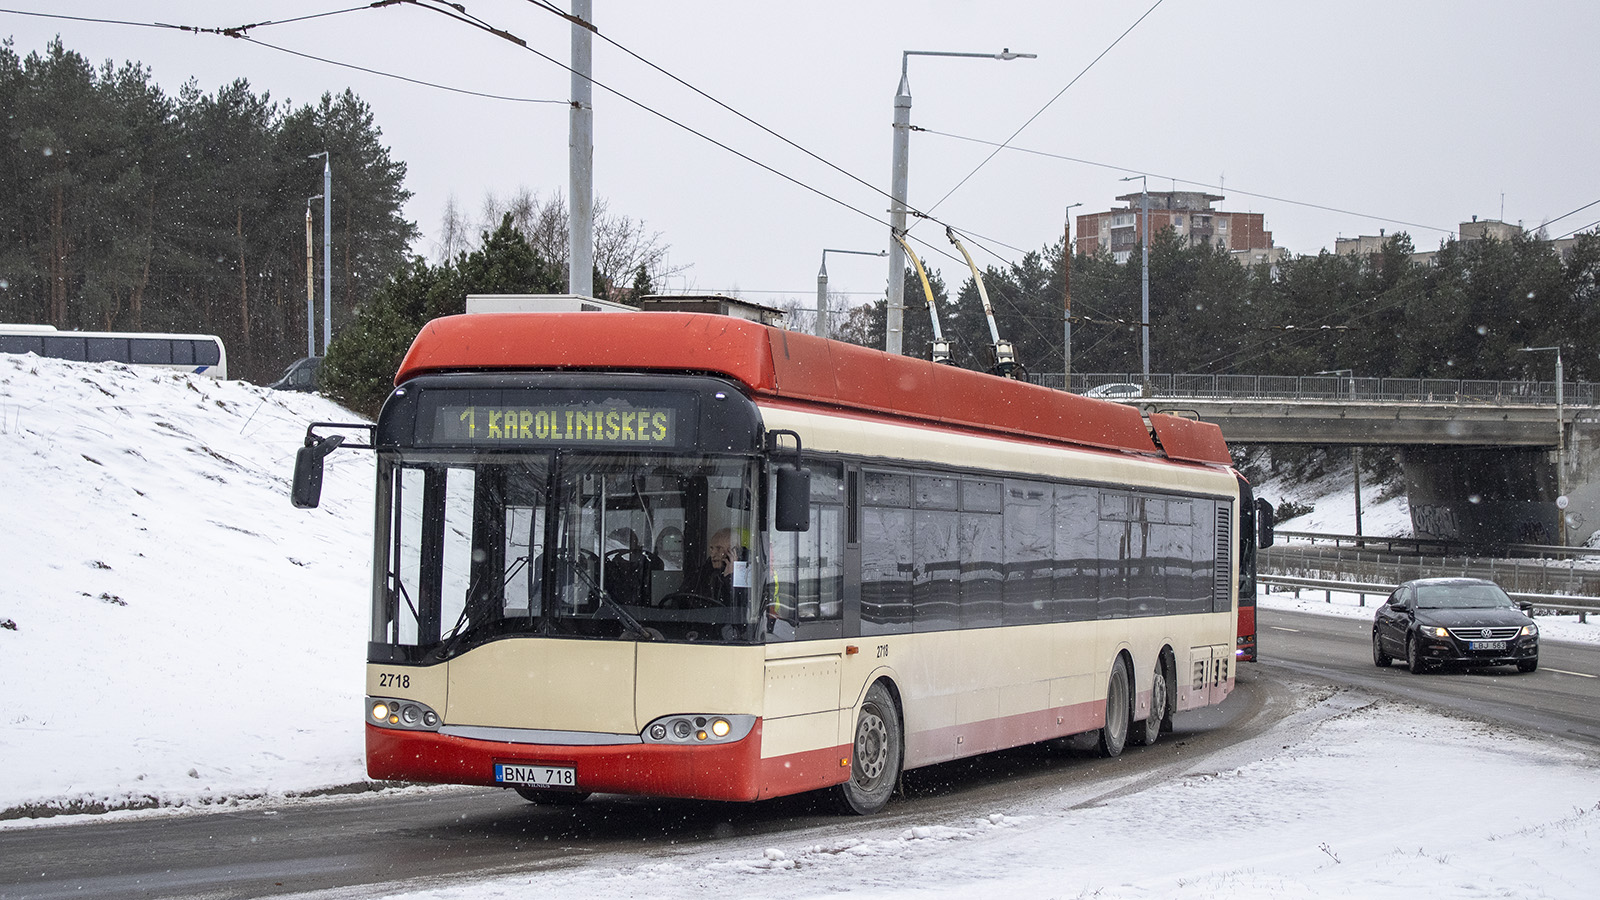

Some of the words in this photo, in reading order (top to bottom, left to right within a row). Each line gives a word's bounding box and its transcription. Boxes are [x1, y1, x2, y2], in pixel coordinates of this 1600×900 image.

[459, 406, 475, 438] 1
[876, 643, 889, 658] 2718
[379, 673, 410, 689] 2718
[505, 767, 536, 783] BNA
[545, 769, 572, 784] 718
